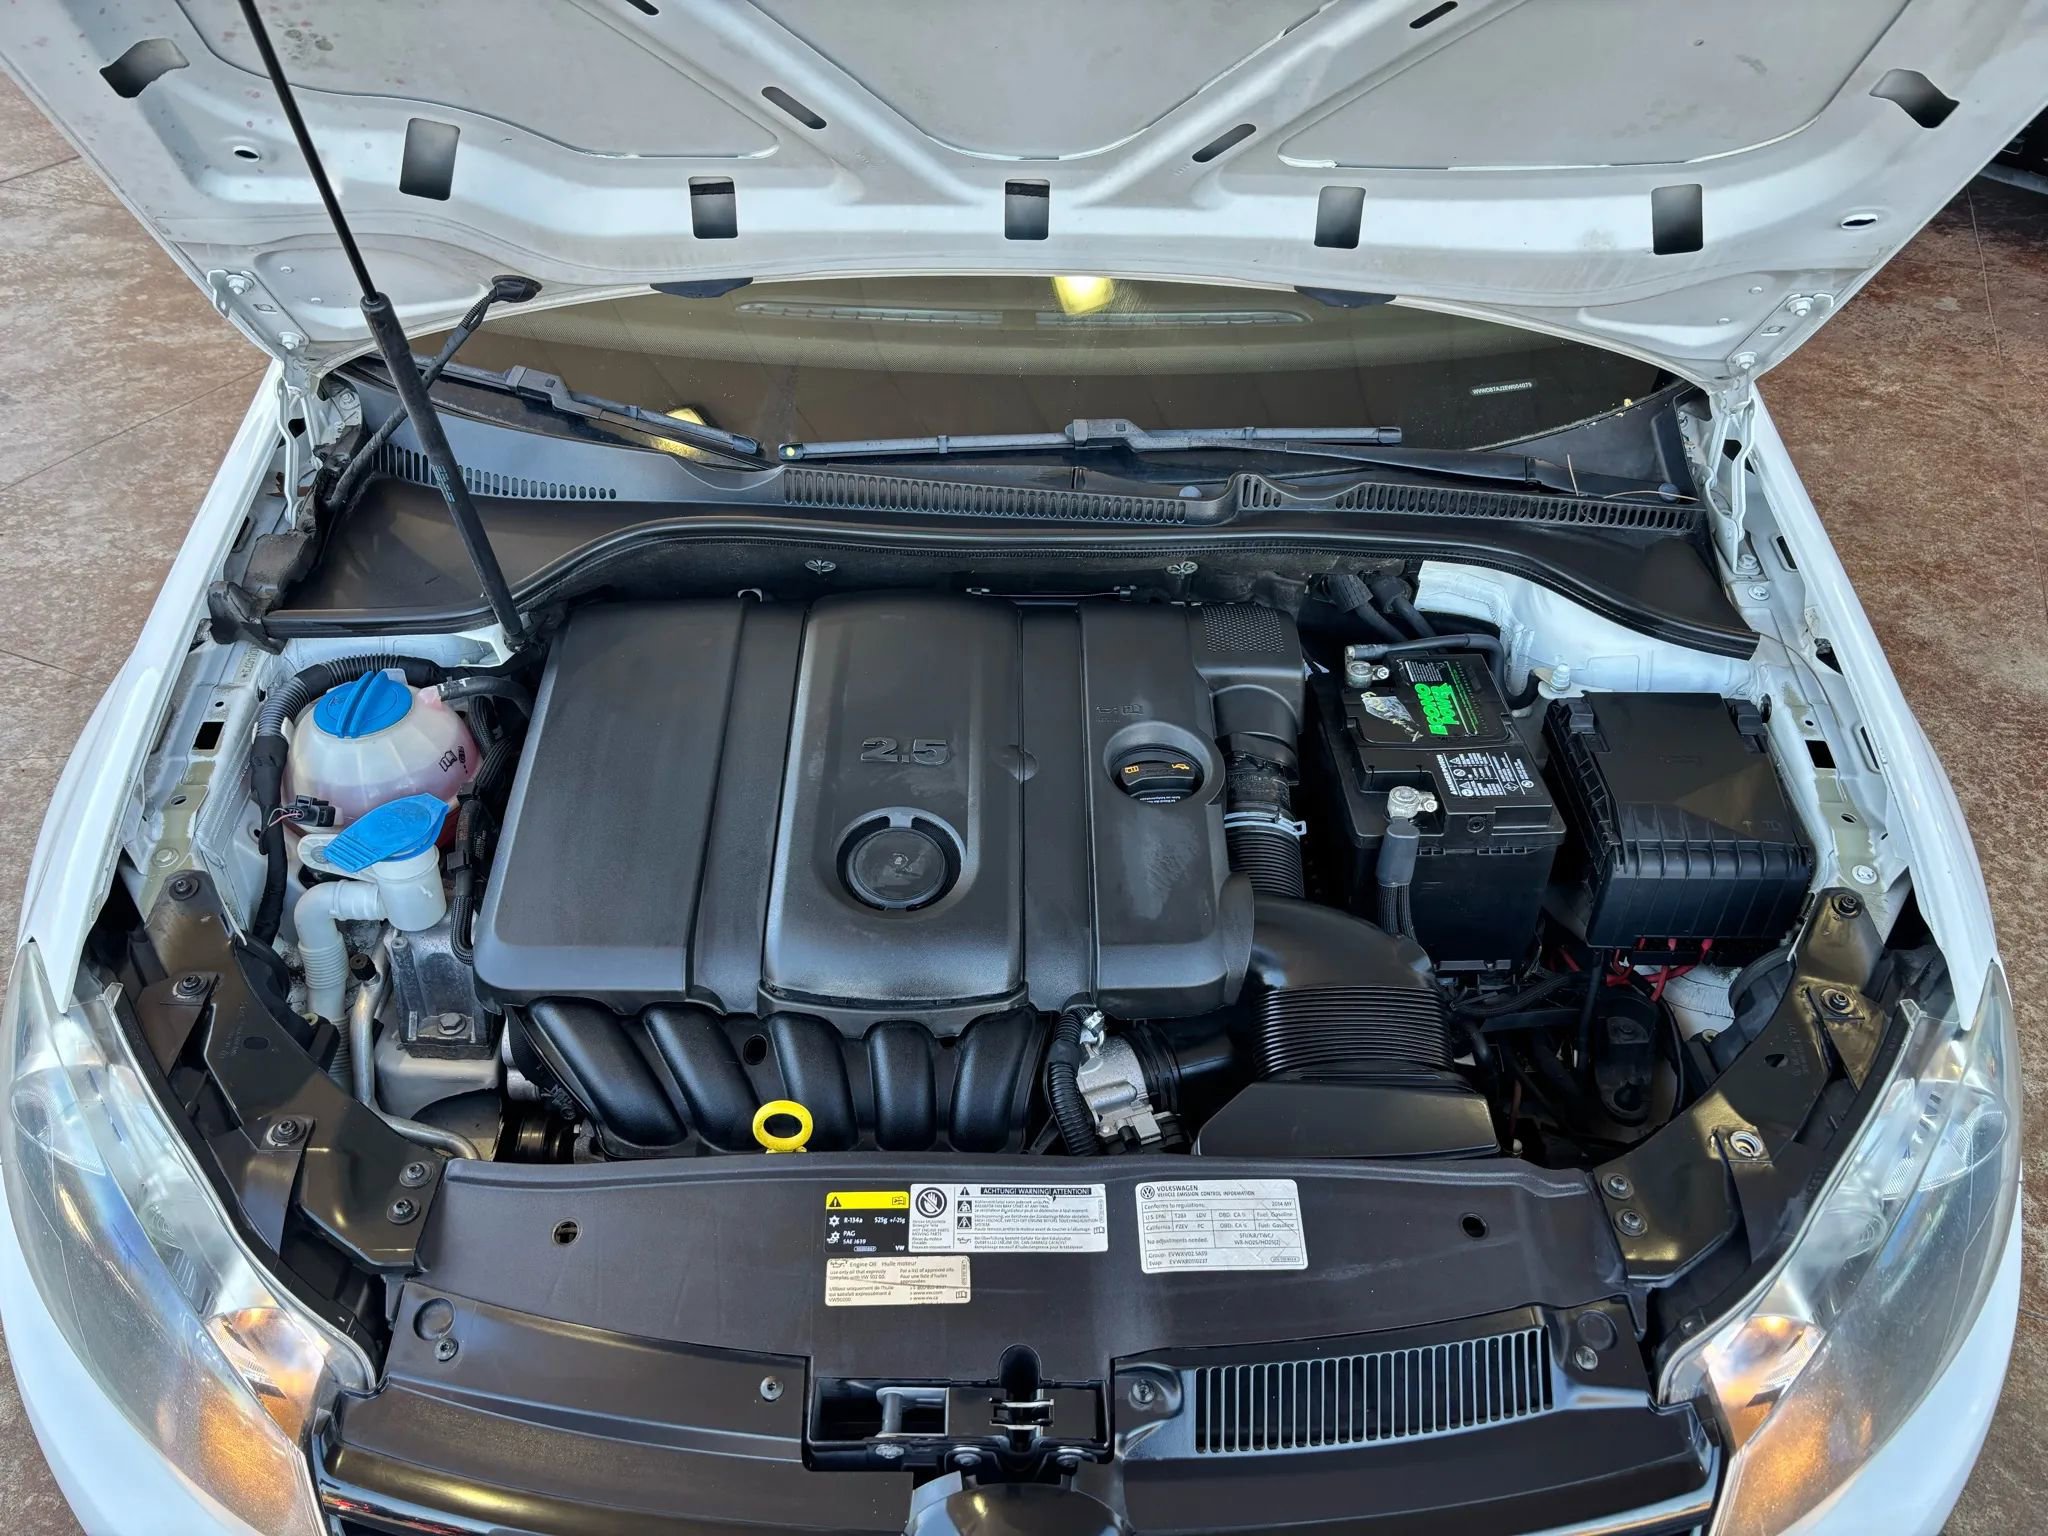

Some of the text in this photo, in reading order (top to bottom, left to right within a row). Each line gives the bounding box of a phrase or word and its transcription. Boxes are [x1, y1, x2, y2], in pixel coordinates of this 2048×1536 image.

[861, 736, 951, 766] 2.5
[843, 1216, 863, 1224] R-134a
[874, 1216, 888, 1225] 525g
